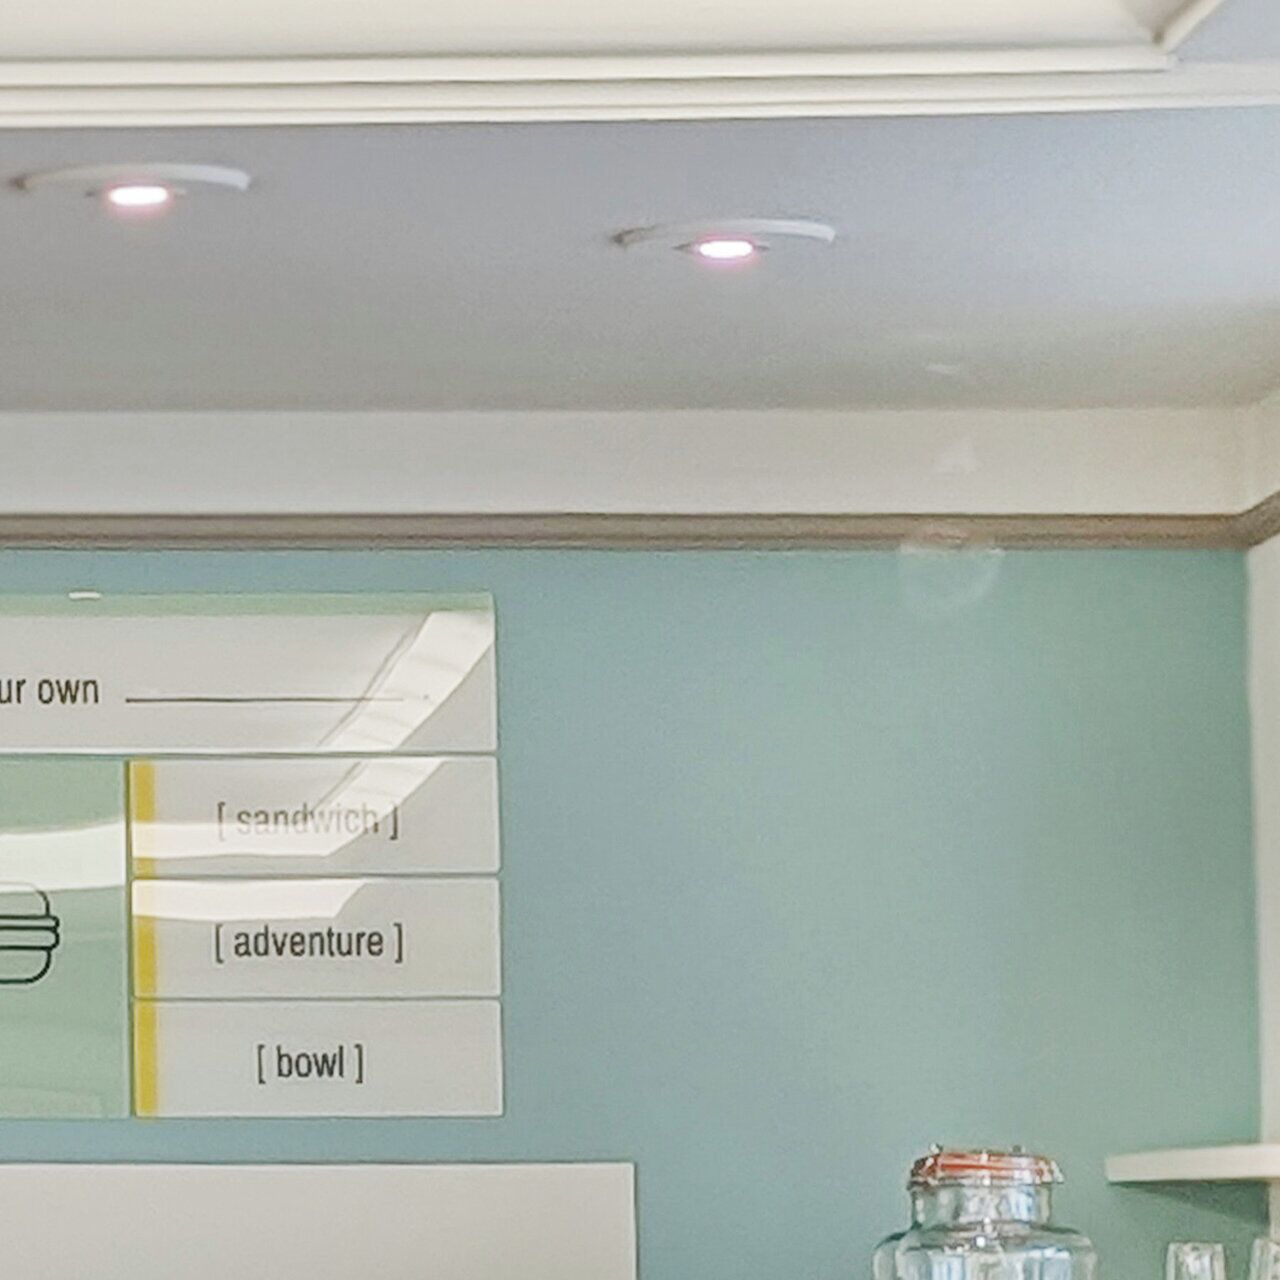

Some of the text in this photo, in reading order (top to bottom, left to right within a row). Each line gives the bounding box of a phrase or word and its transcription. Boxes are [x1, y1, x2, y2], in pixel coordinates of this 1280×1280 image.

[37, 678, 99, 705] own
[236, 802, 380, 836] sandwich
[233, 924, 384, 958] adventure
[275, 1044, 345, 1079] bowl
